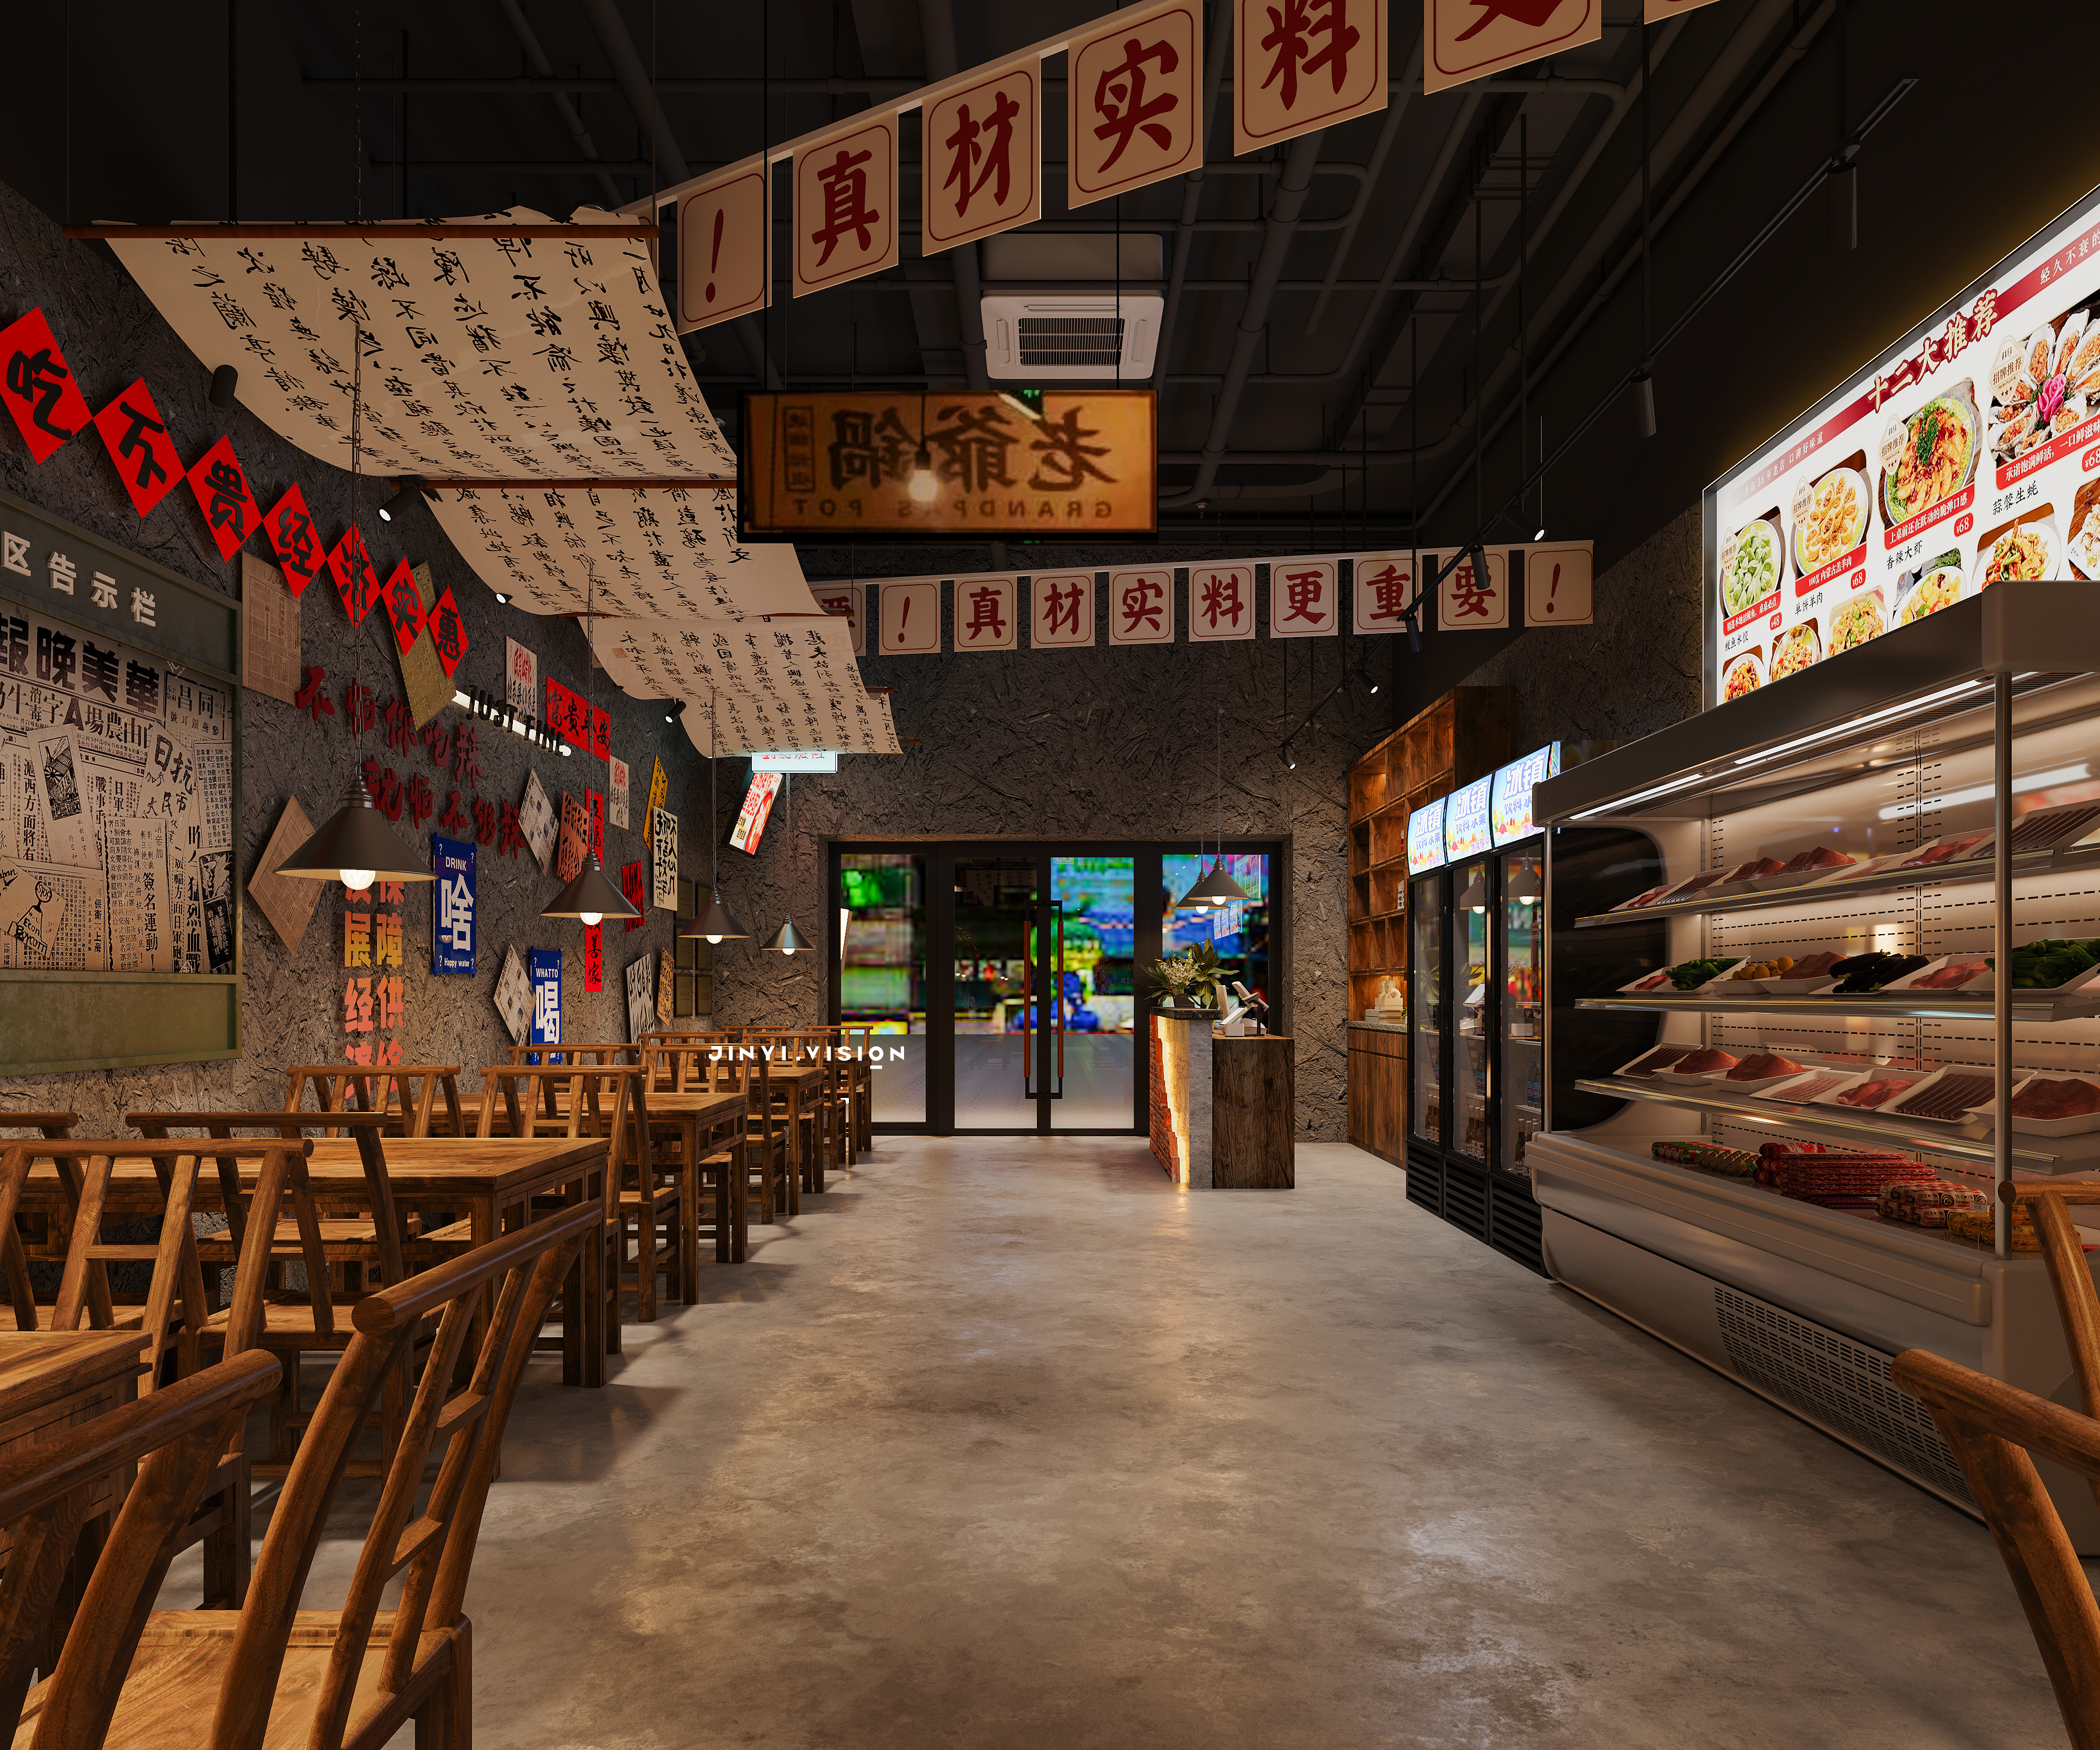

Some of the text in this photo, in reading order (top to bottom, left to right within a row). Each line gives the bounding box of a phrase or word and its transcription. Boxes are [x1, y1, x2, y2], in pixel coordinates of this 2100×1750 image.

[1868, 290, 1998, 412] 十二大推荐
[1993, 357, 2022, 385] 招牌推荐
[1789, 431, 1824, 464] 口碑好味道
[1882, 435, 1904, 457] 招牌推荐
[1793, 497, 1812, 514] 招牌推荐
[1993, 480, 2039, 516] 蒜蓉生蚝
[1956, 517, 1970, 534] ¥68
[1886, 540, 1923, 570] 香辣大虾
[1852, 572, 1863, 586] ¥68
[1771, 615, 1780, 628] ¥48
[1503, 753, 1545, 800] 冰镇
[1455, 781, 1488, 821] 冰镇
[1504, 793, 1532, 816] 饮料水
[1415, 803, 1443, 838] 冰镇
[1522, 821, 1541, 837] 冰爽
[445, 856, 467, 871] DRINK
[441, 873, 474, 951] 啥
[444, 957, 457, 968] Happy
[458, 958, 470, 967] water
[536, 981, 560, 1044] 喝
